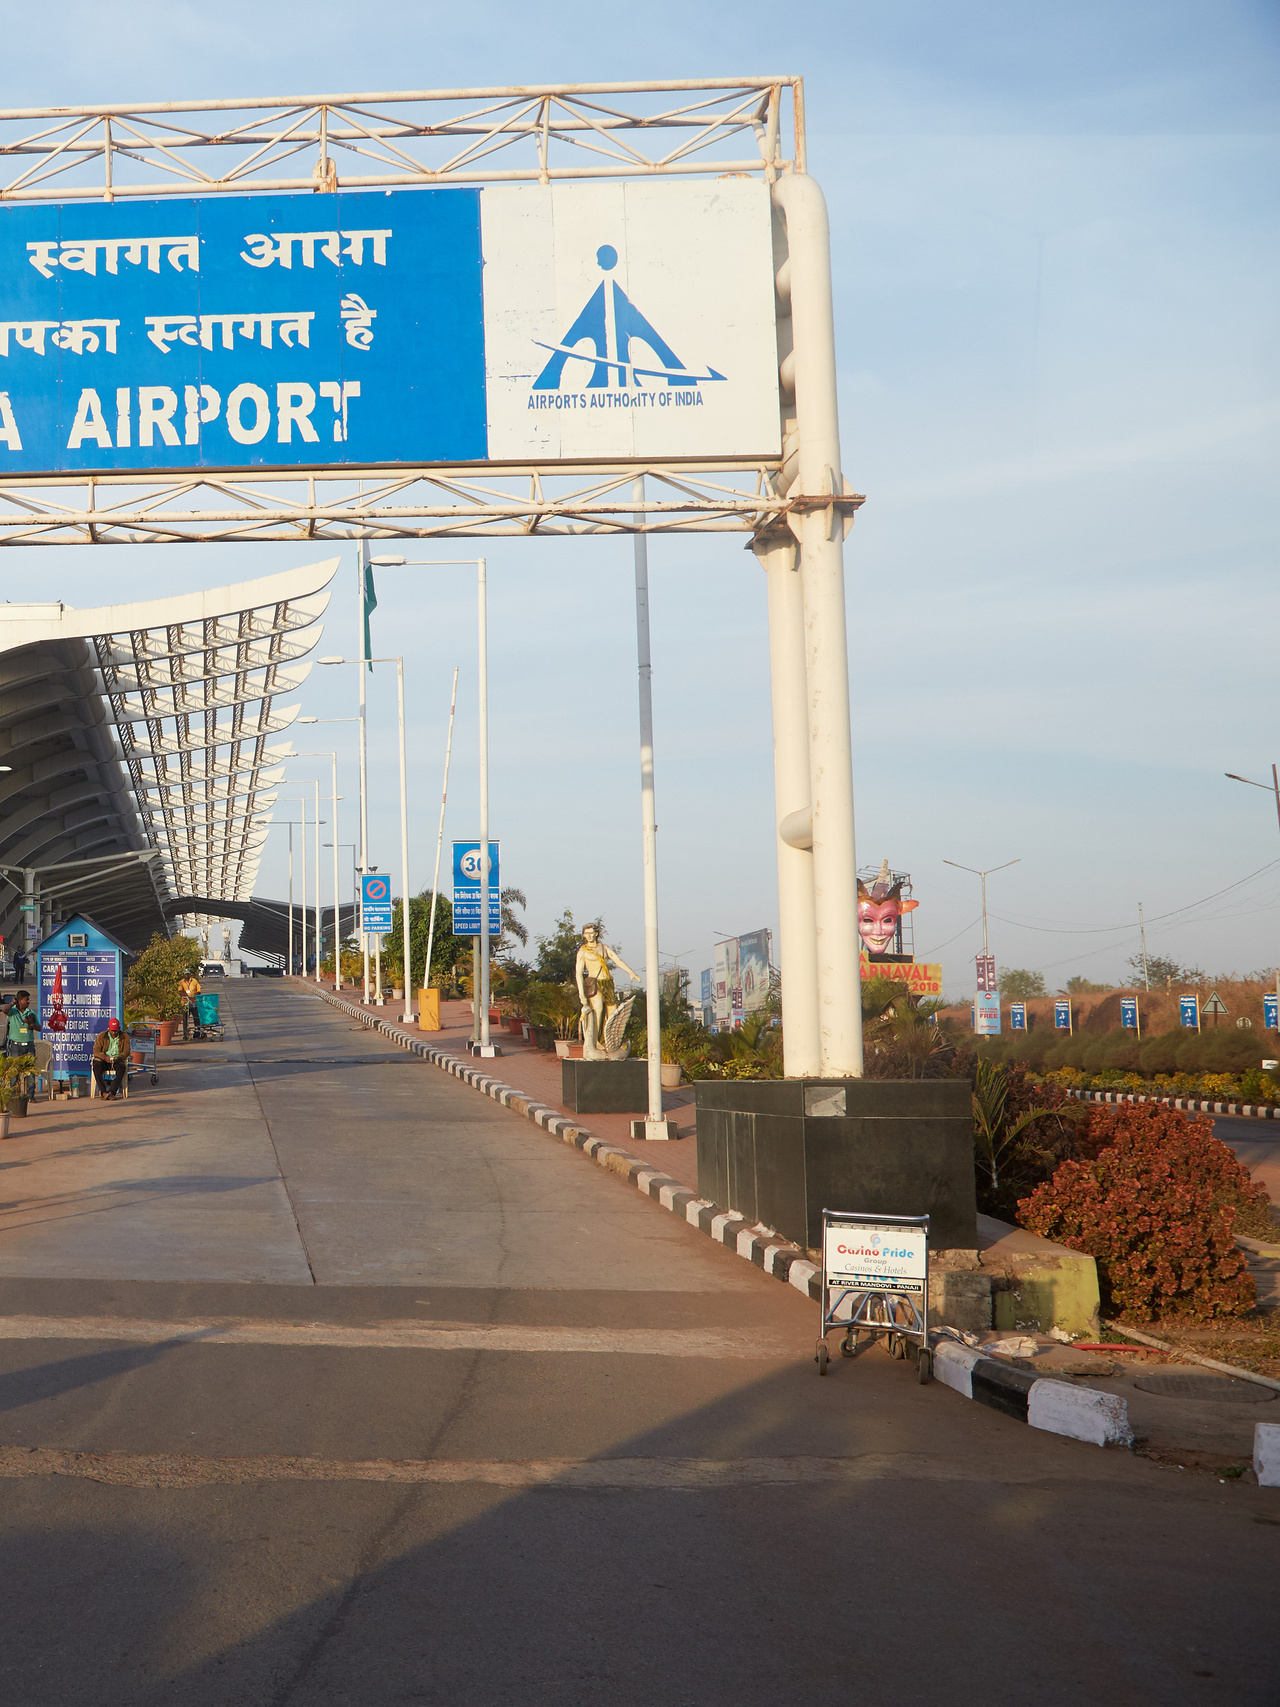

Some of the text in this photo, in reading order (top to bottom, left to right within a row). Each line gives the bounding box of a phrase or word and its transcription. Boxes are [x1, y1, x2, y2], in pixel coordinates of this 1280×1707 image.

[27, 236, 200, 278] स्वागत
[240, 229, 392, 269] आसा
[145, 311, 314, 354] स्वागत
[340, 293, 377, 351] है
[527, 391, 704, 409] AIRPORTS AUTHORITY OF INDIA
[67, 381, 361, 450] AIRPORT
[859, 965, 932, 981] ARNAVAL
[84, 979, 102, 987] 100/-
[912, 982, 939, 991] 2018
[92, 994, 101, 1005] FREE
[85, 1009, 97, 1018] ENTRY
[98, 1009, 111, 1018] TICKET
[78, 1021, 88, 1029] GATE
[43, 1033, 55, 1041] ENTRY
[62, 1033, 70, 1041] EXIT
[71, 1033, 82, 1041] POINT
[64, 1054, 88, 1062] CHARGED
[837, 1244, 915, 1258] Casino Pride
[864, 1257, 887, 1265] Group
[844, 1263, 873, 1272] Casinos
[883, 1266, 907, 1275] Hotels
